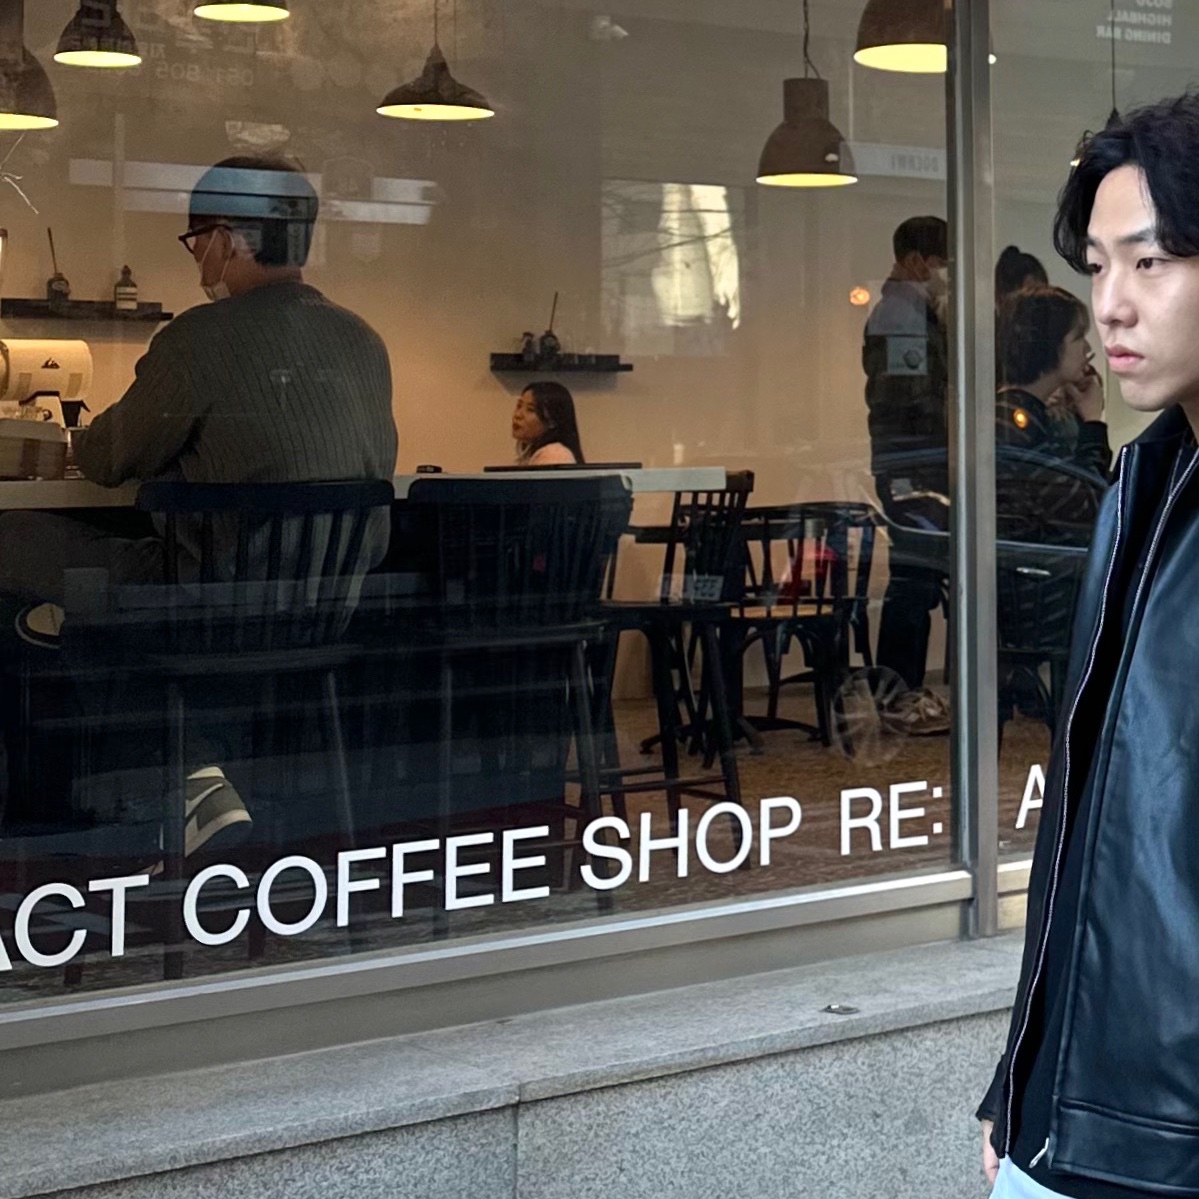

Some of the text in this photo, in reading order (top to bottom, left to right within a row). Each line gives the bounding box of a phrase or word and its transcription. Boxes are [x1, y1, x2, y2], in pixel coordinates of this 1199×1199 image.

[183, 825, 550, 945] COFFEE
[580, 796, 802, 890] SHOP
[840, 780, 943, 856] RE:
